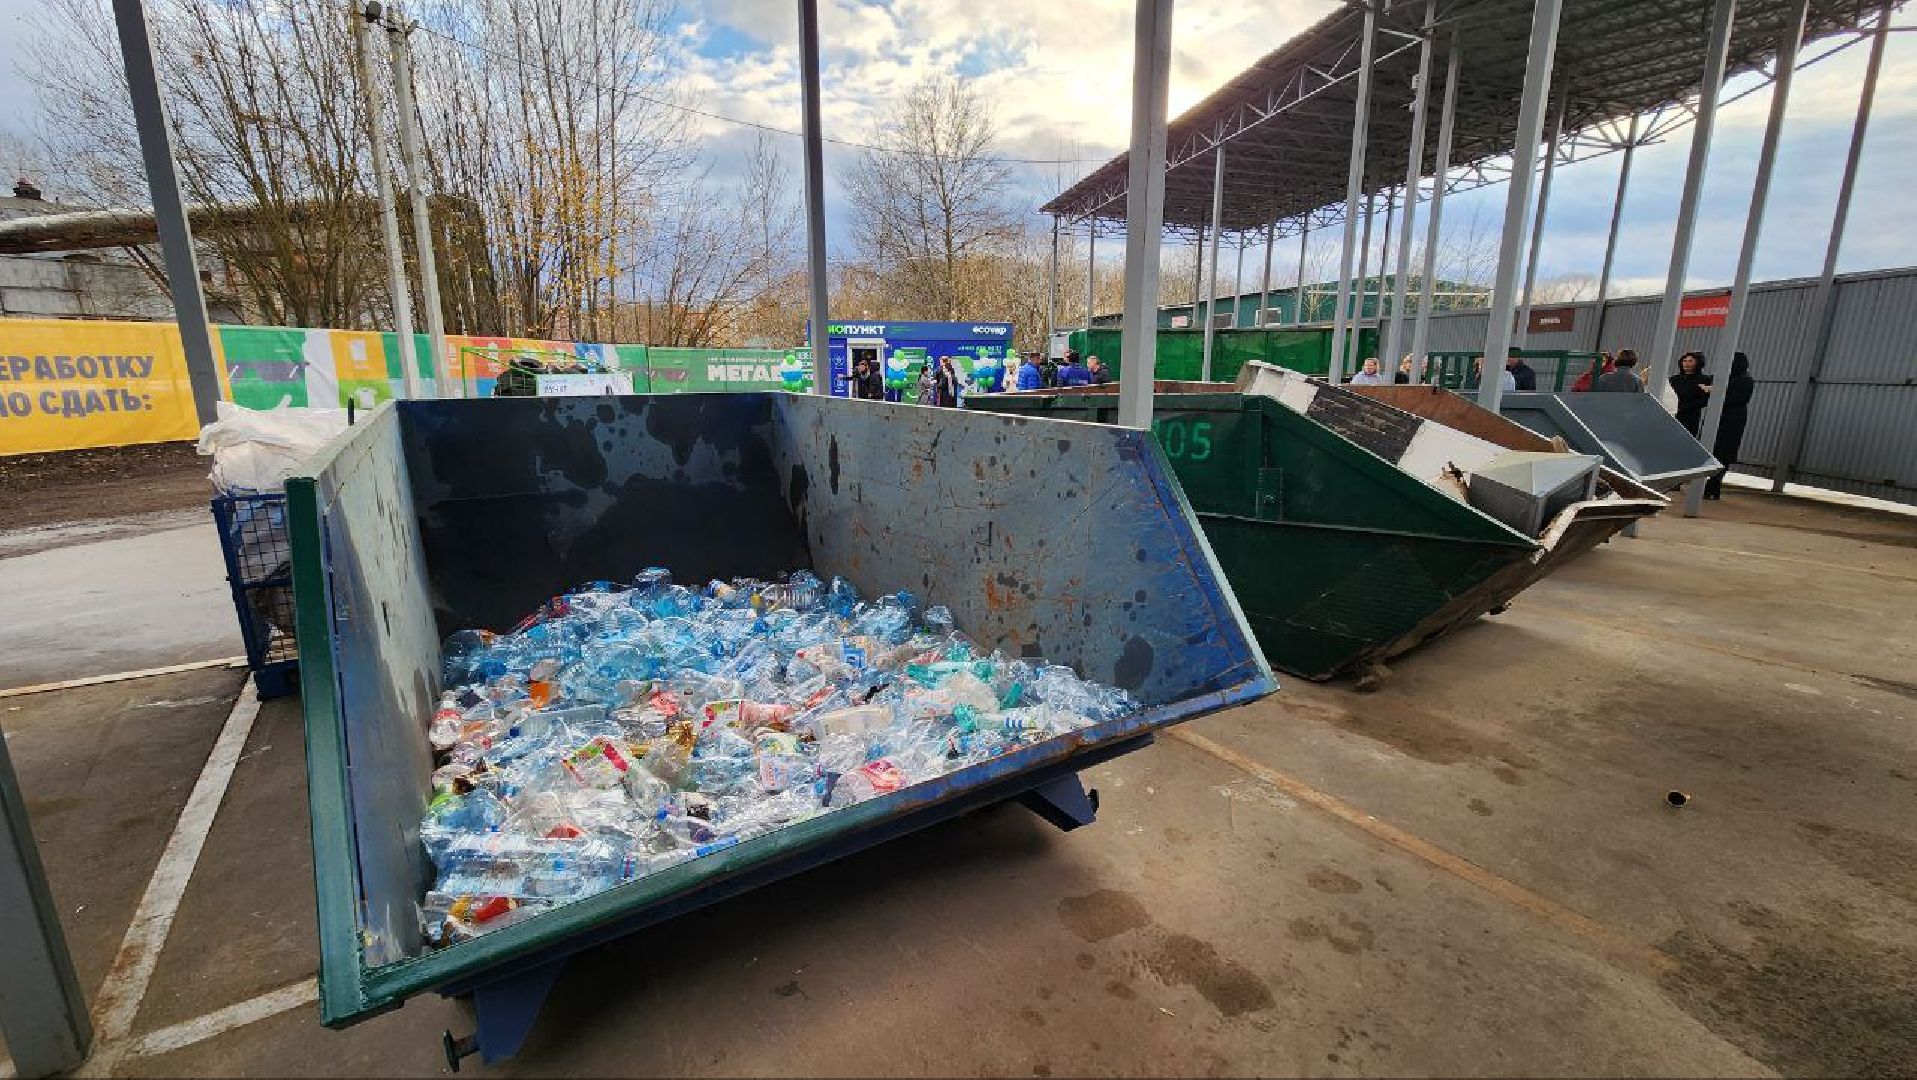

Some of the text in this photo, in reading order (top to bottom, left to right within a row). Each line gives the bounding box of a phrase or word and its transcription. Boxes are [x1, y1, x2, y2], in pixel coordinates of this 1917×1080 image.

[0, 355, 154, 381] ЕРАБОТКУ
[39, 388, 152, 417] СДАТЬ:
[1153, 418, 1212, 460] 05
